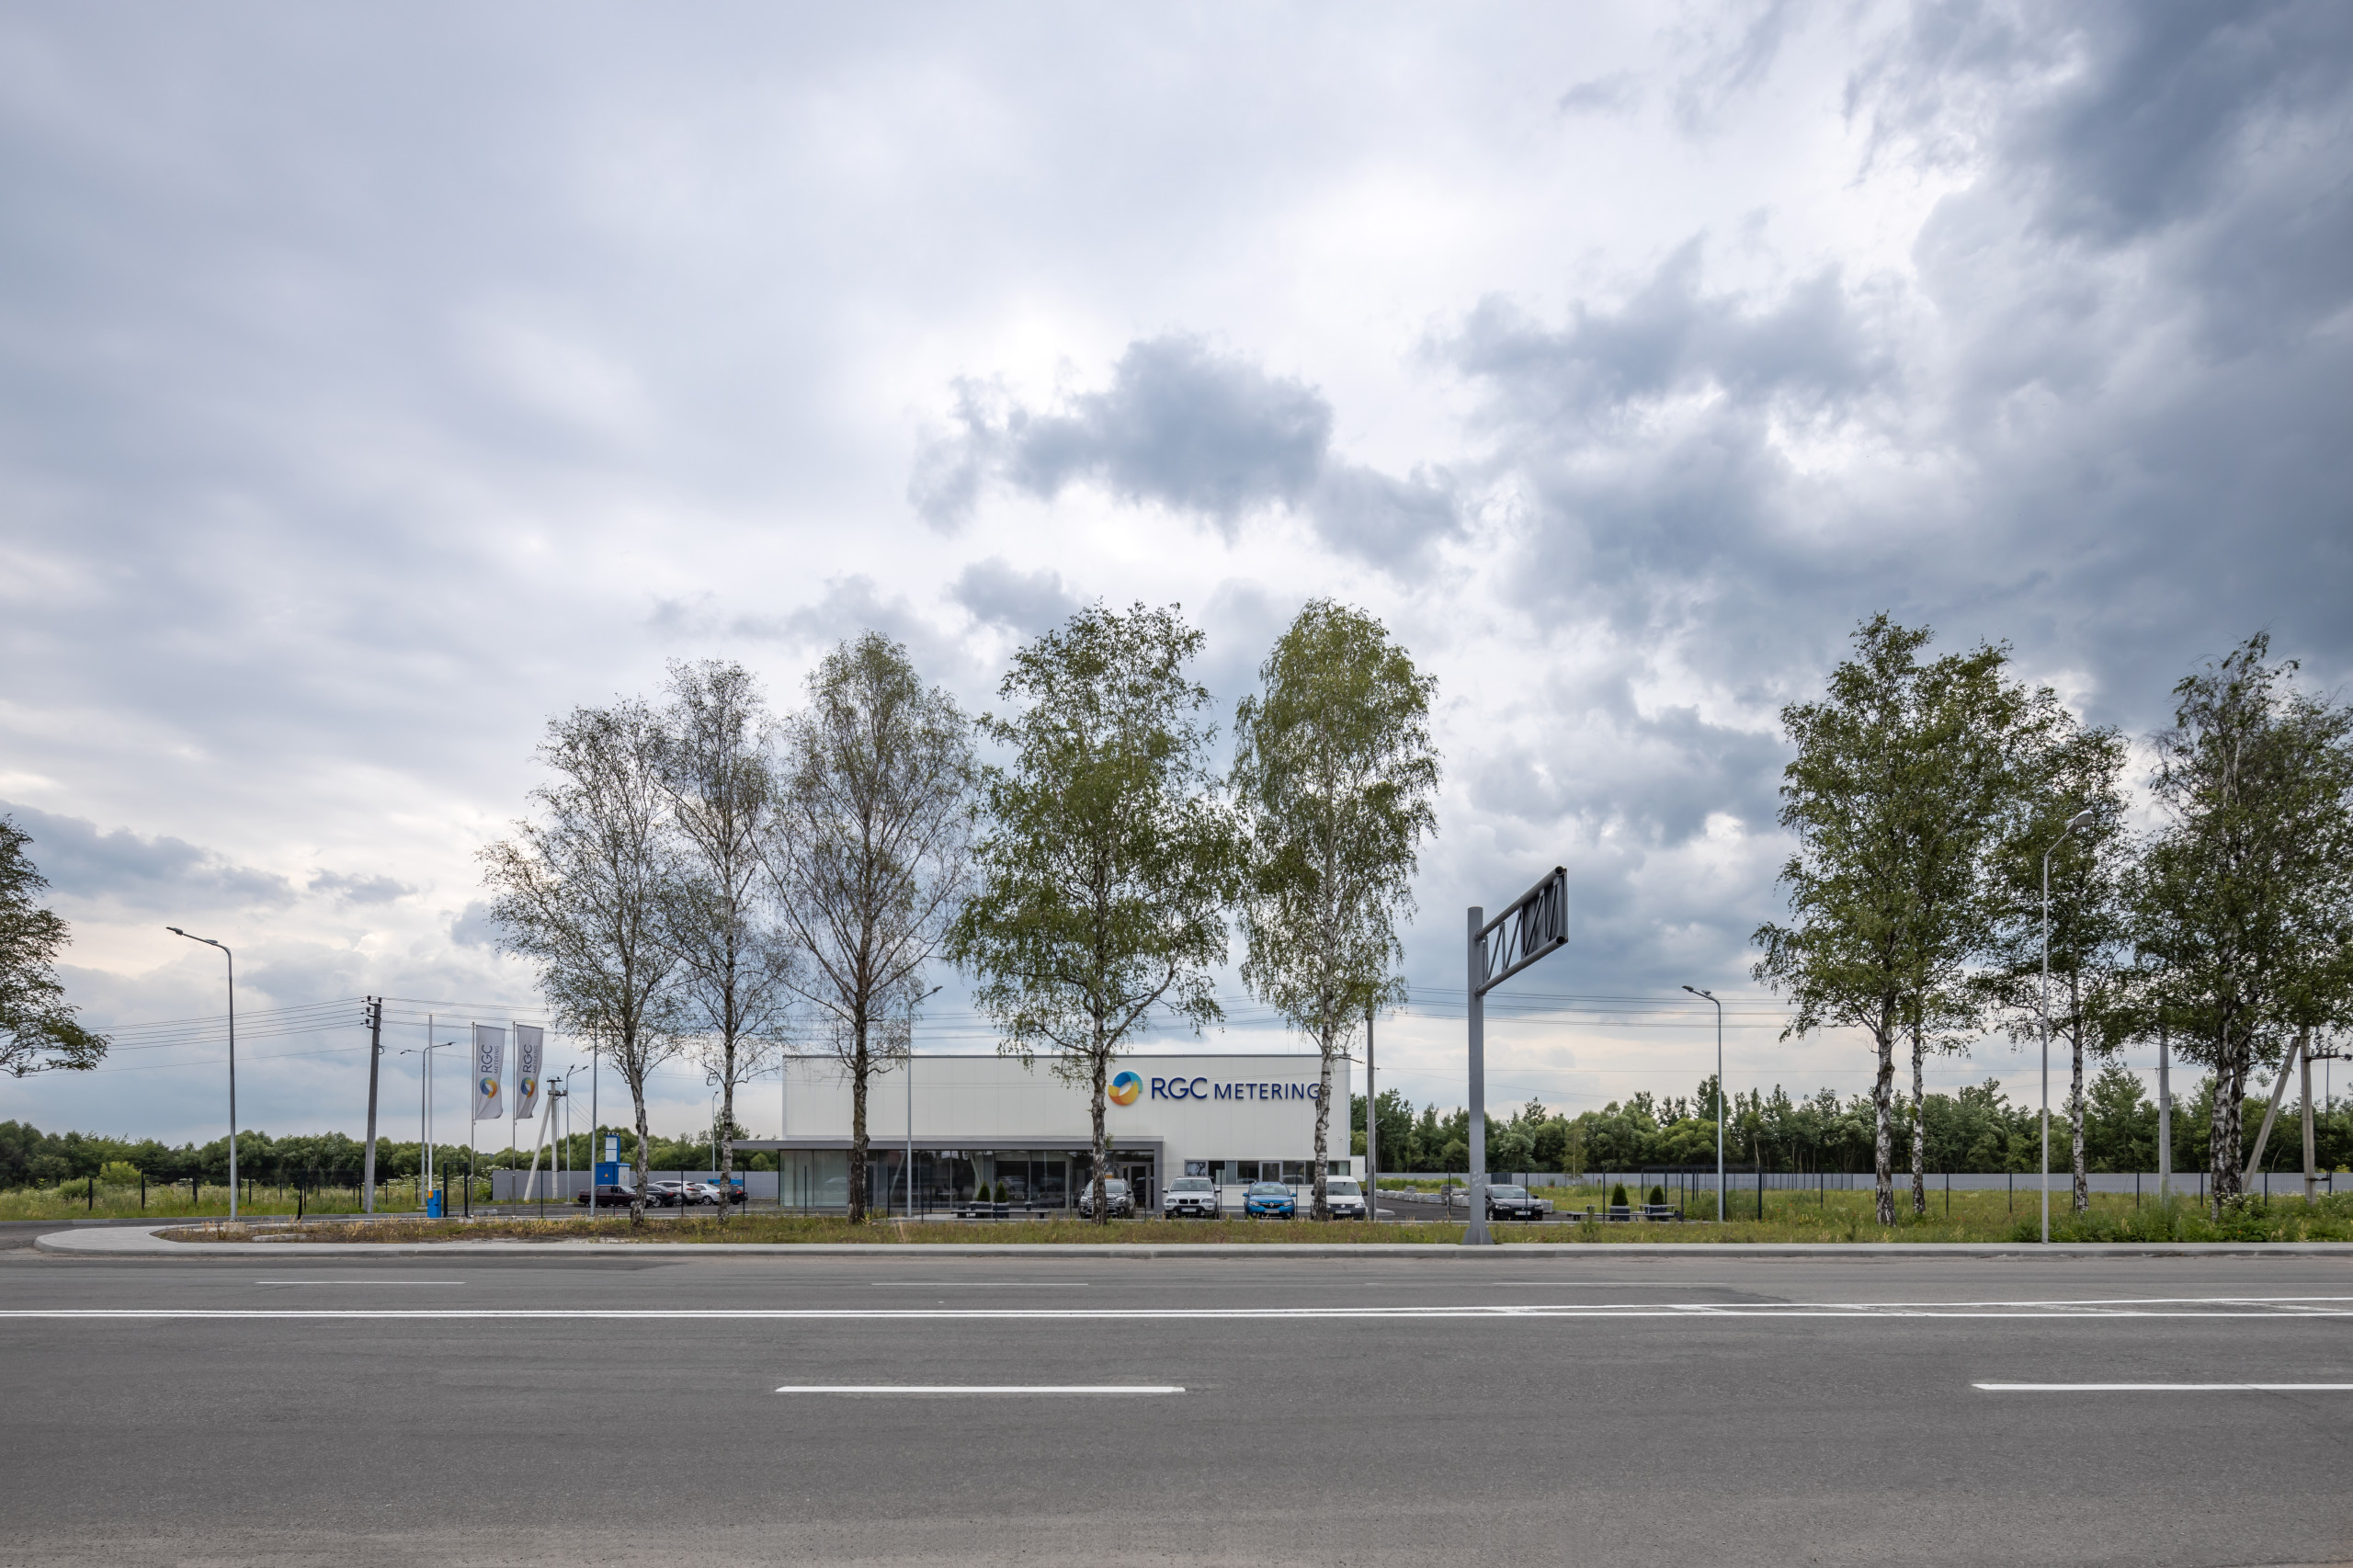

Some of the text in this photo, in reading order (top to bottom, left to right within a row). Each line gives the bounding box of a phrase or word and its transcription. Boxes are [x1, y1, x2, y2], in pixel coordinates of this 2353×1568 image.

[481, 1044, 493, 1074] RGC
[522, 1043, 533, 1074] RGC
[1151, 1077, 1320, 1099] RGC METERING
